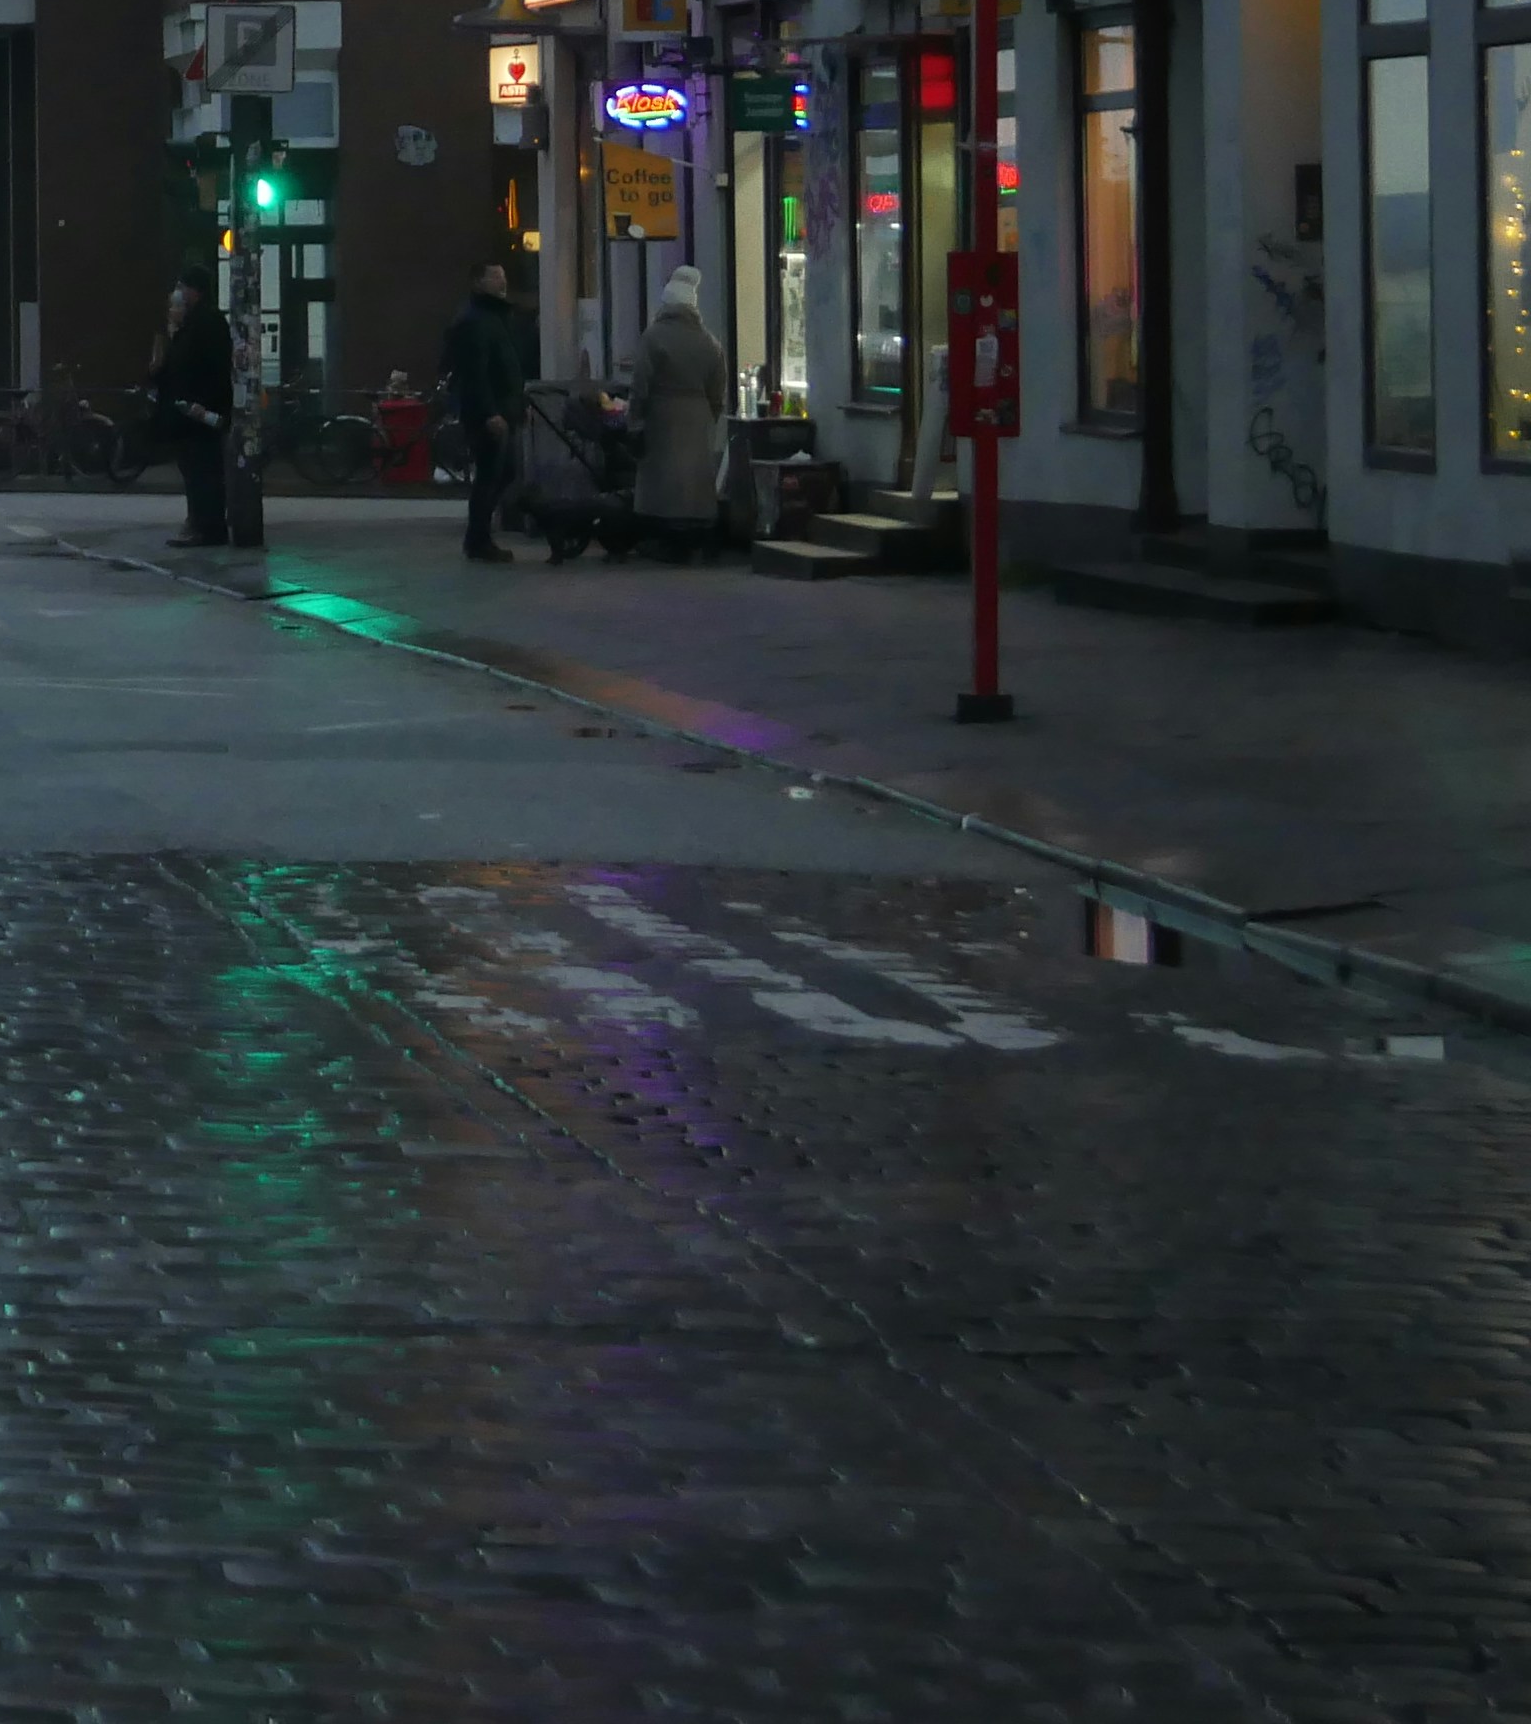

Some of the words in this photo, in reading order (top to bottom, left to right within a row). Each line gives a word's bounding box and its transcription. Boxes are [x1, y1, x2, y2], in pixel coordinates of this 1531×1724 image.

[617, 93, 677, 113] Kiosk
[607, 168, 672, 184] Coffee
[620, 188, 639, 202] to
[648, 190, 673, 207] go
